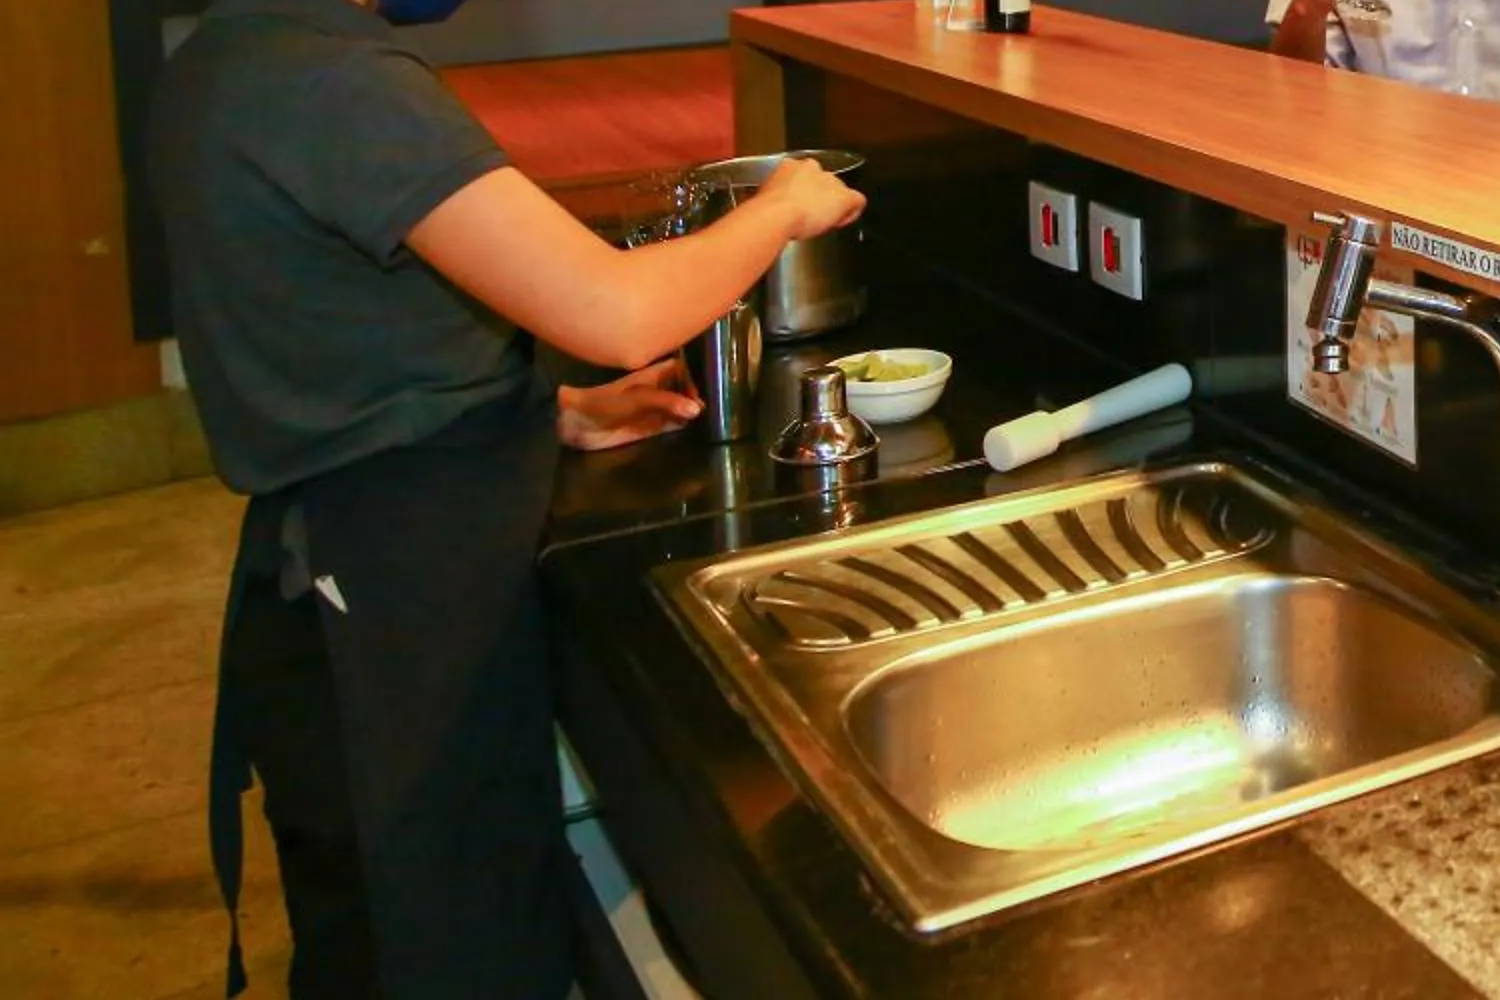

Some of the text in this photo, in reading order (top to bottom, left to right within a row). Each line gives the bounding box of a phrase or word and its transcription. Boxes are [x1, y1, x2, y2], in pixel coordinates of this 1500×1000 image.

[1393, 227, 1420, 252] NÃO
[1422, 235, 1477, 271] RETIRAR
[1479, 254, 1491, 274] O
